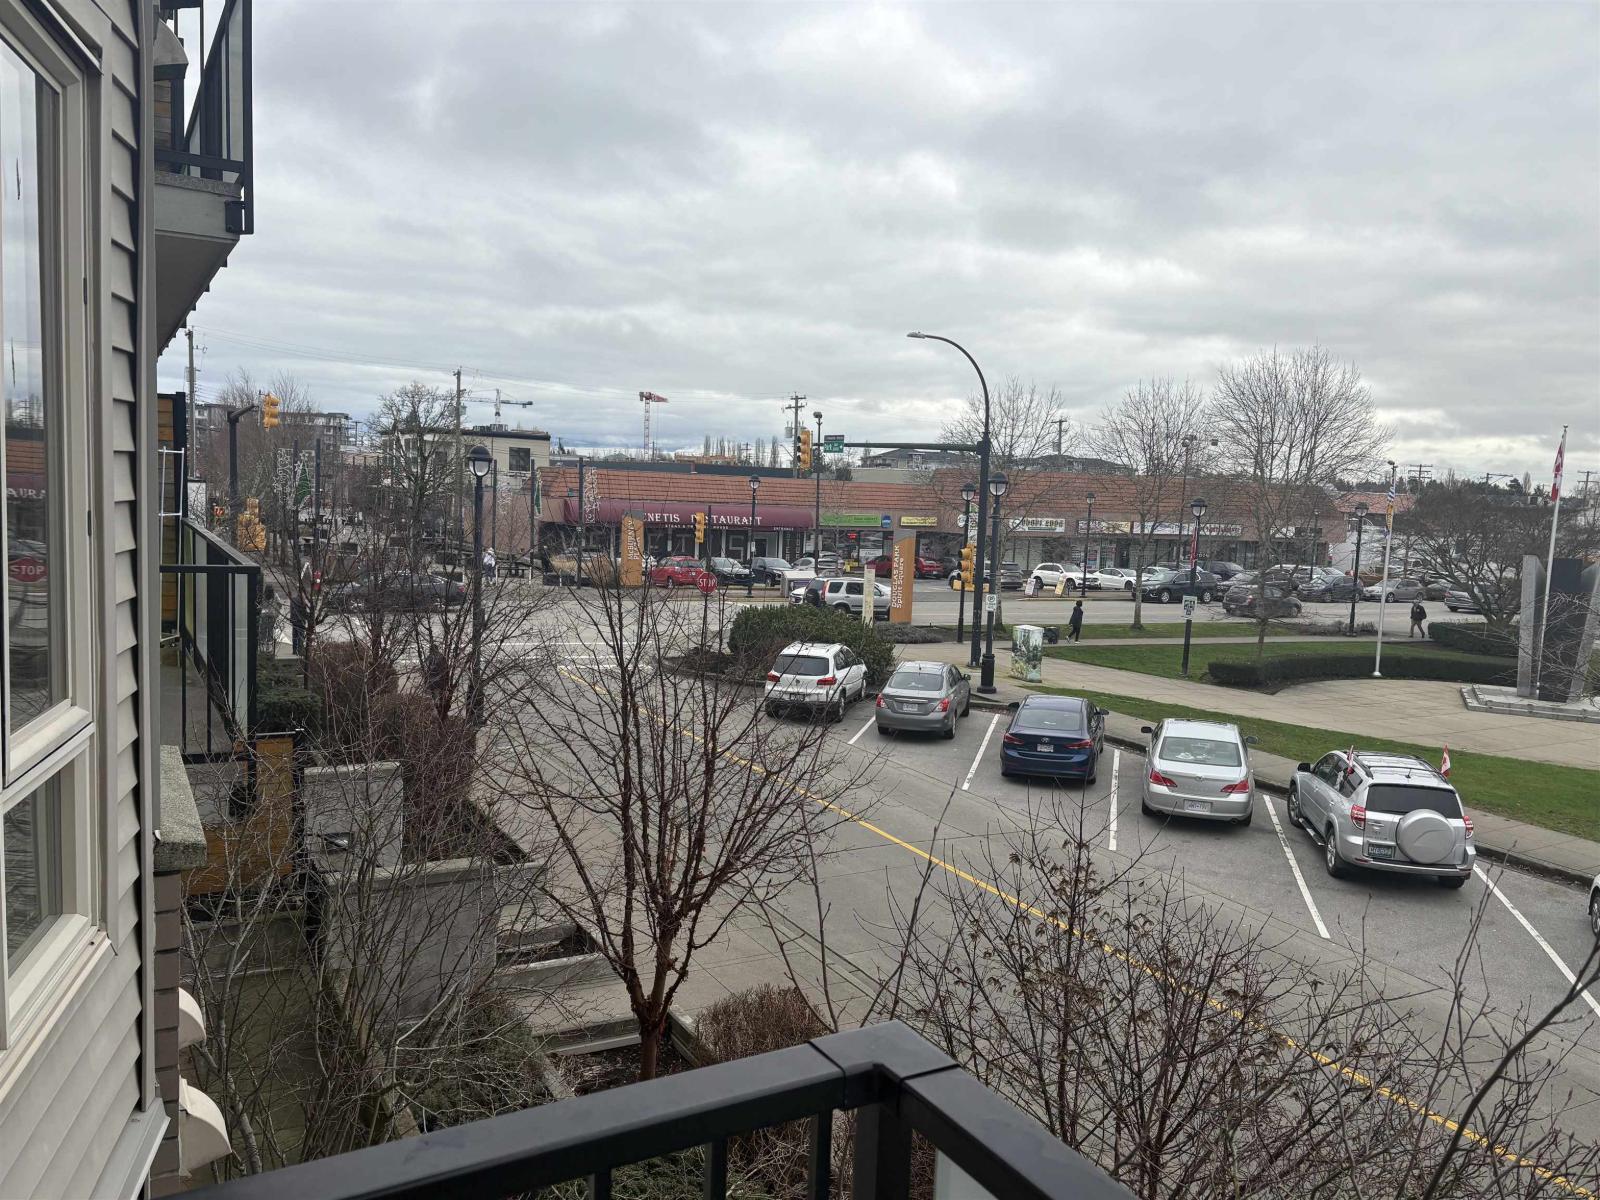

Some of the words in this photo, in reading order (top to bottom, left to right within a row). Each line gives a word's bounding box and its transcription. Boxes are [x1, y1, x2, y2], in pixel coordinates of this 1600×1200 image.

[643, 512, 680, 523] NETIS
[691, 514, 762, 525] RSTAURAT
[9, 565, 45, 575] STOP
[699, 578, 715, 587] STOP
[891, 569, 899, 608] DOUGLAS
